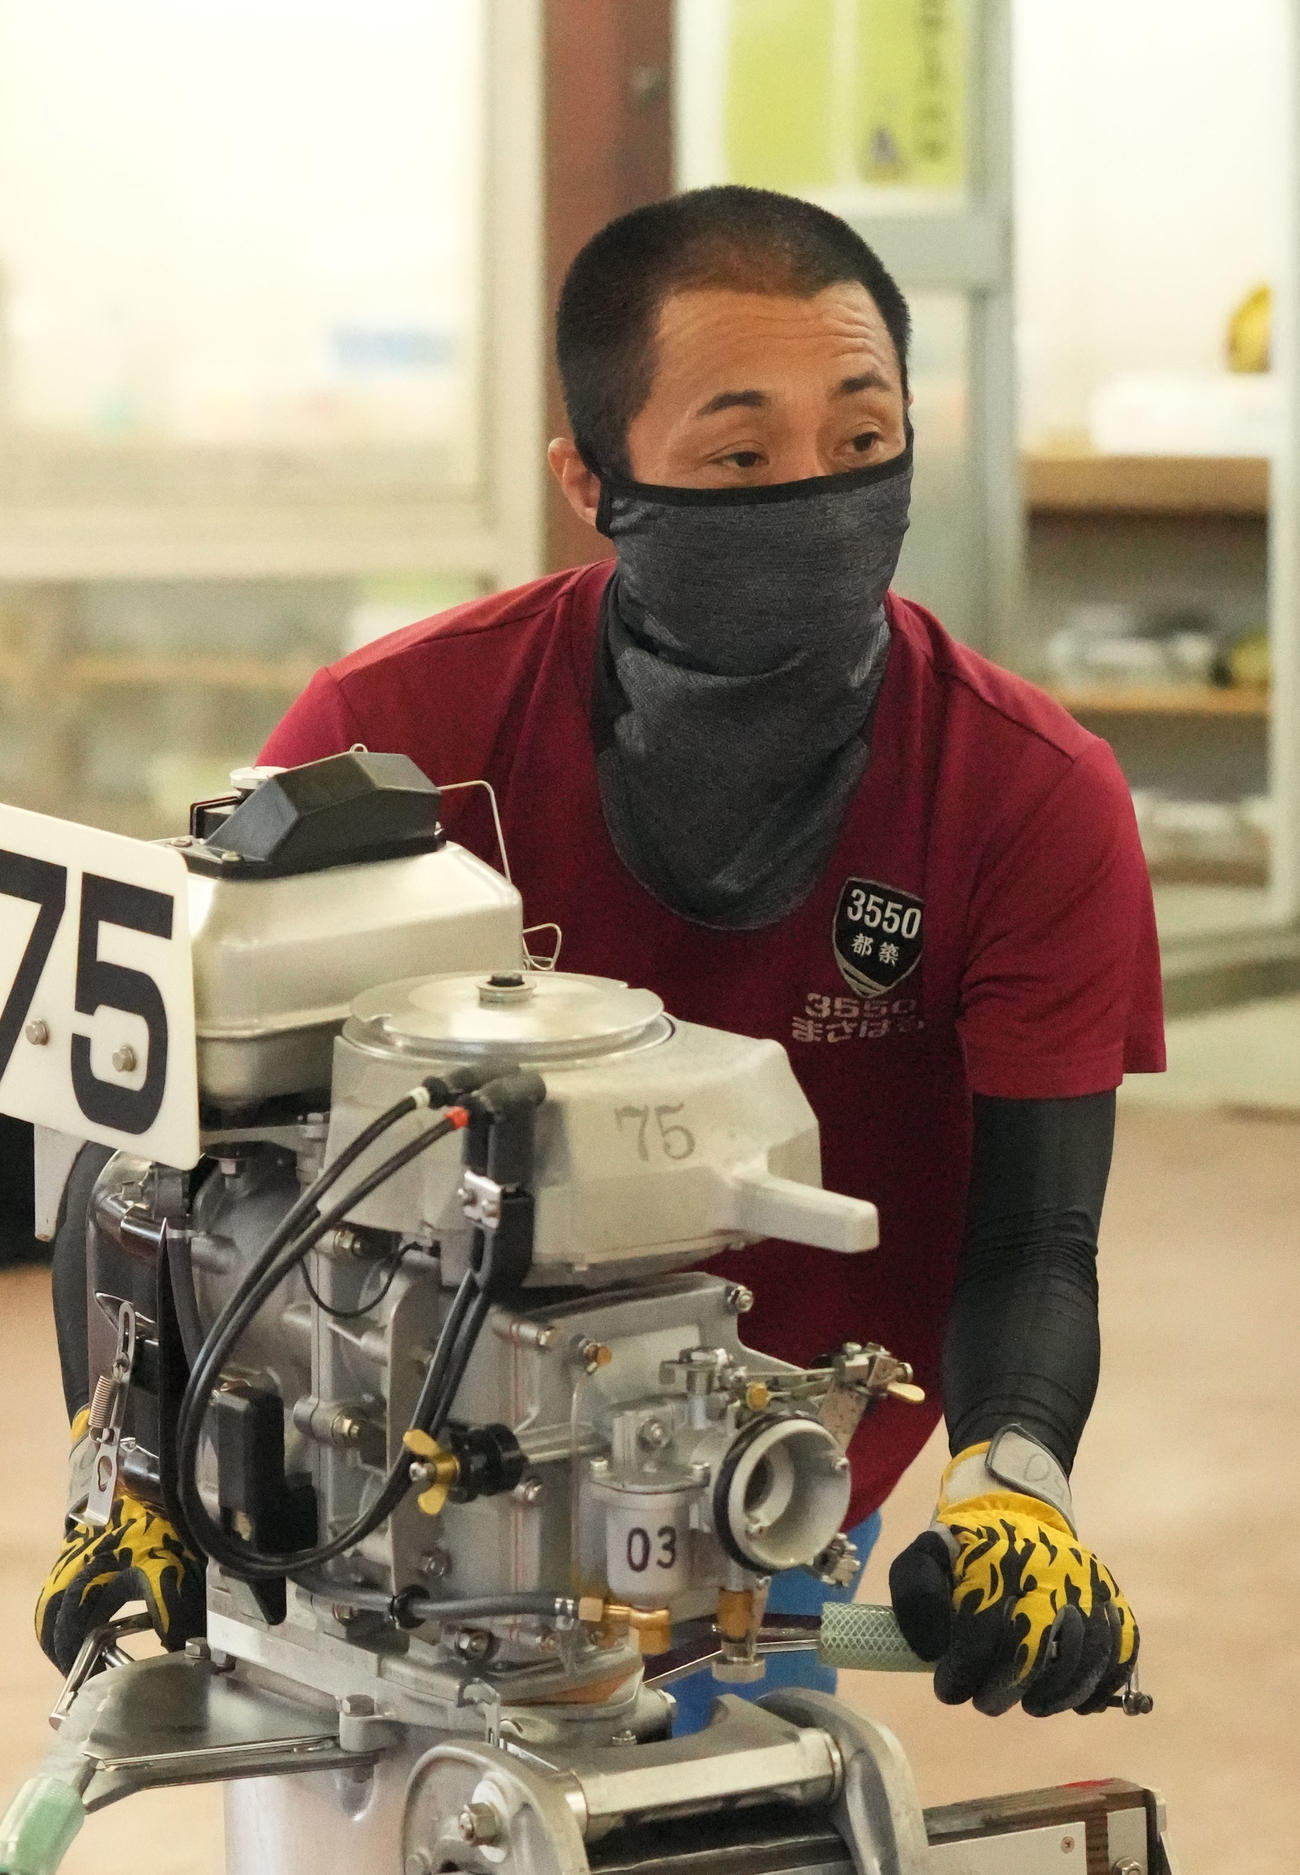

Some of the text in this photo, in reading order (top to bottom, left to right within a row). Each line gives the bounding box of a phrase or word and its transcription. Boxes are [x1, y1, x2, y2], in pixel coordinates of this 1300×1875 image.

[847, 889, 921, 938] 3550
[0, 848, 174, 1135] 75
[805, 993, 916, 1018] 3550
[614, 1102, 695, 1162] 75
[626, 1526, 677, 1573] 03
